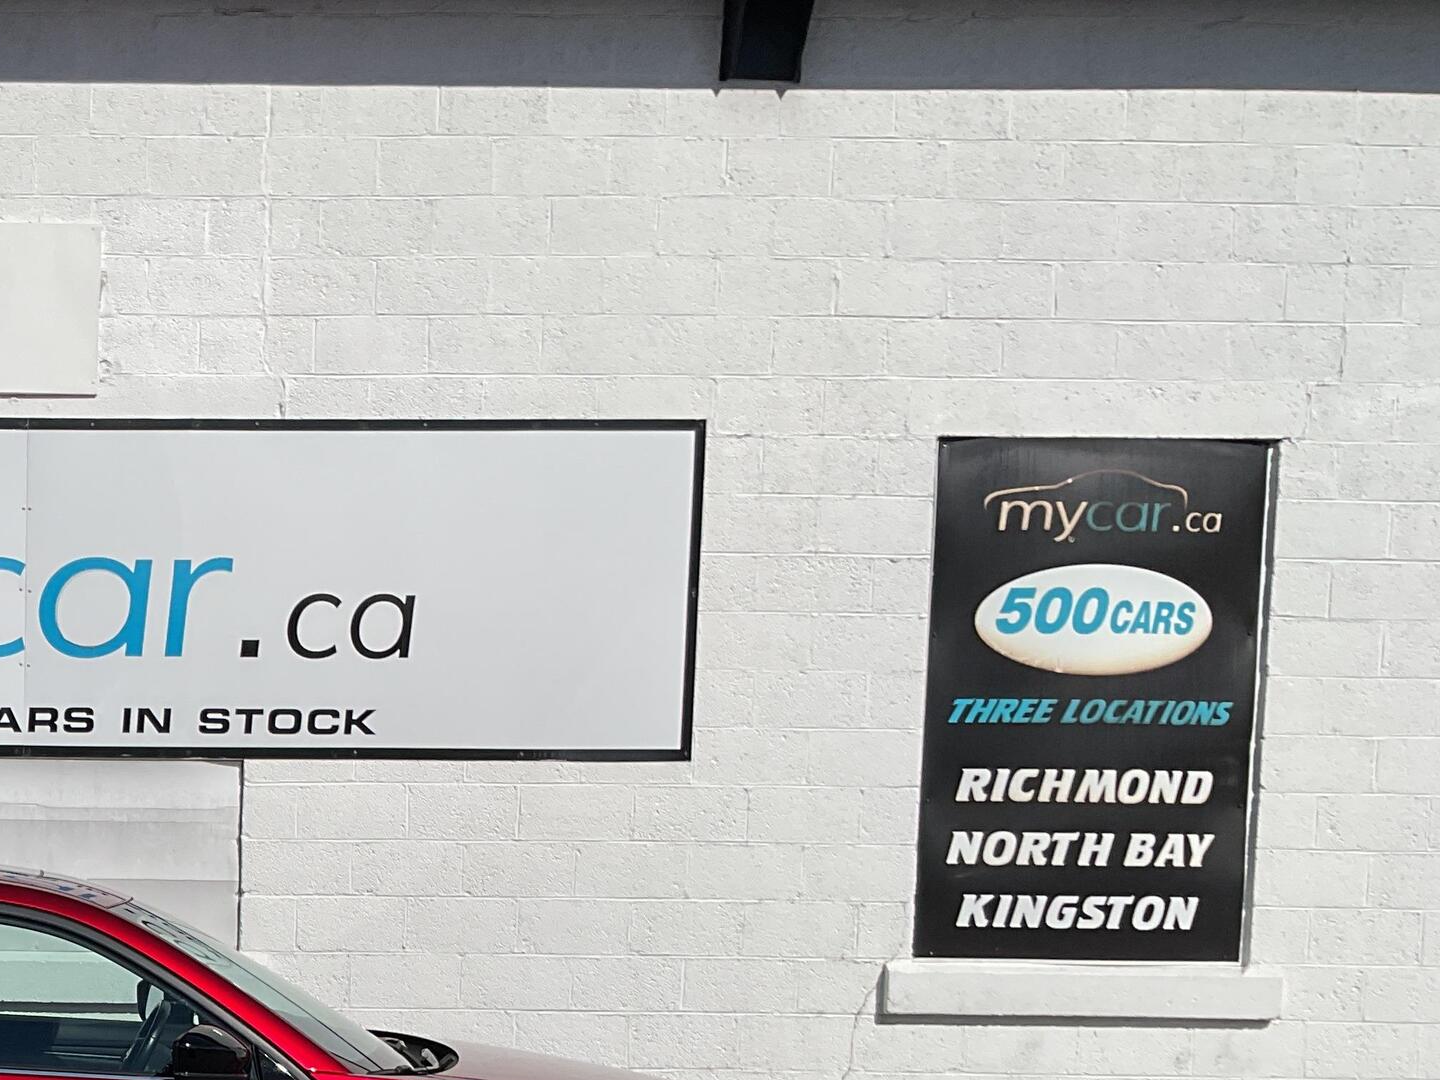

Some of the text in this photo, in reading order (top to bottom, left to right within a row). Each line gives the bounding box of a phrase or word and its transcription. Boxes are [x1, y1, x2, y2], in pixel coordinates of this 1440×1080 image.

[995, 586, 1196, 635] 500 CARS
[122, 707, 172, 734] IN
[198, 708, 377, 736] STOCK
[948, 698, 1234, 726] THREE LOCATIONS
[955, 768, 1214, 805] RICHMOND
[945, 830, 1216, 868] NORTH BAY
[955, 893, 1200, 931] KINGSTON
